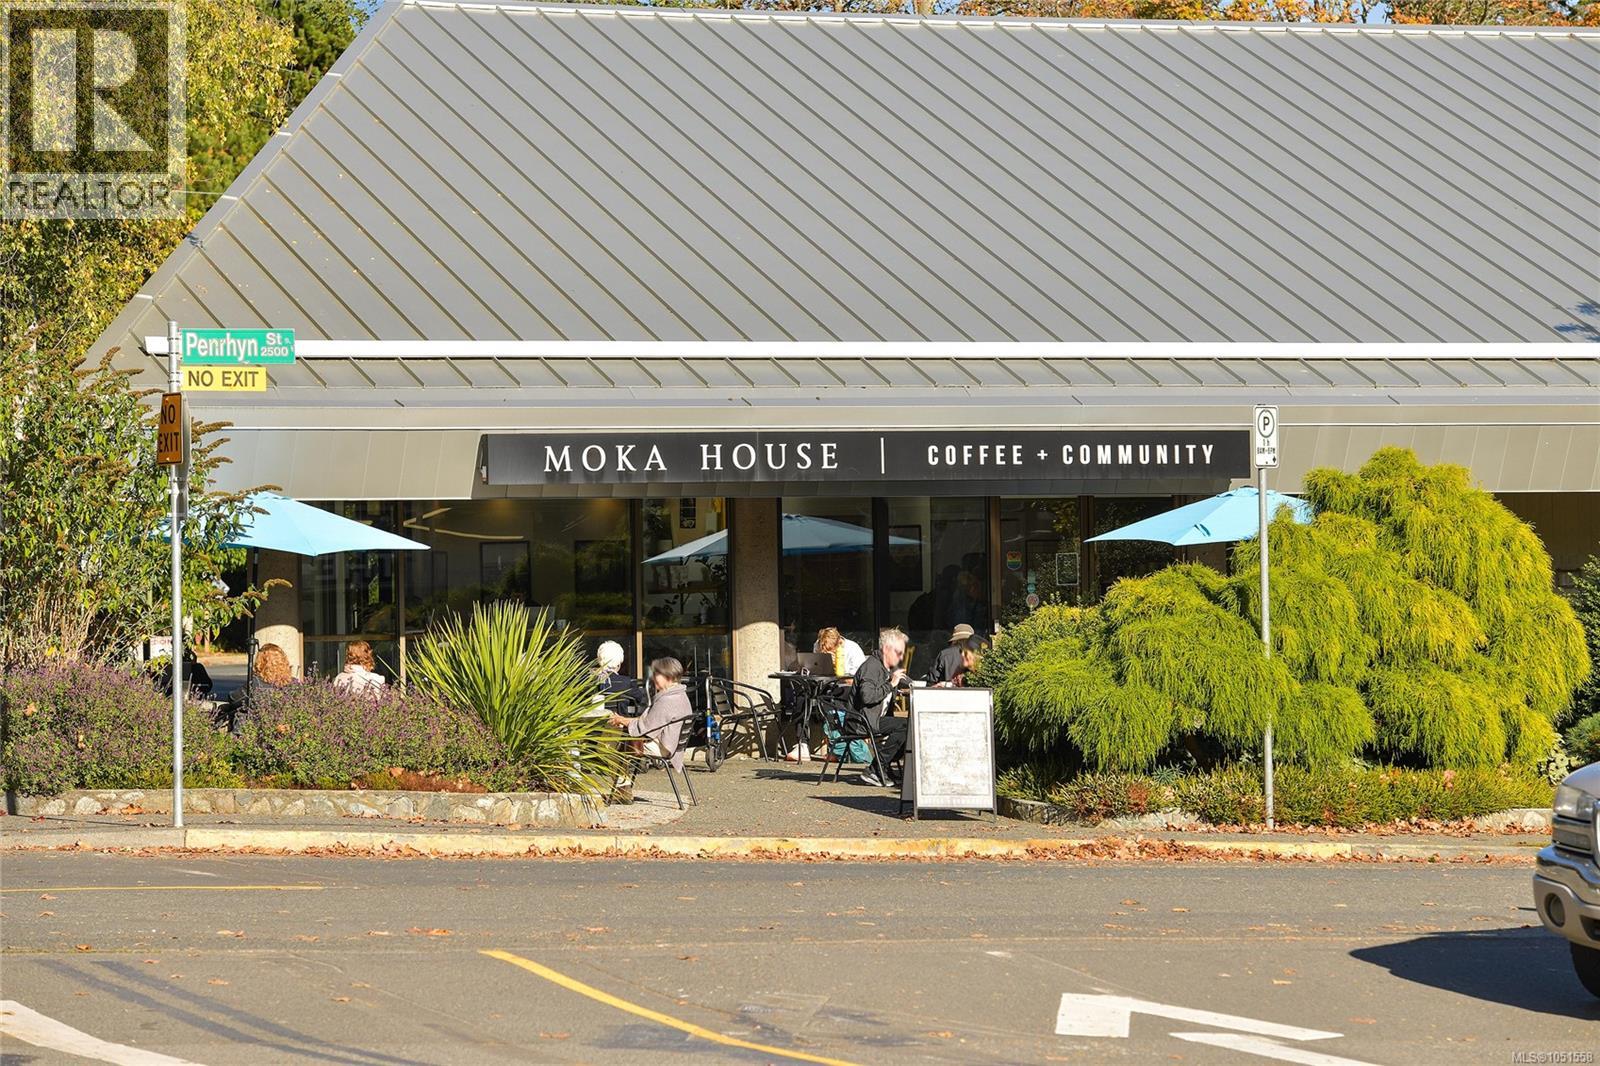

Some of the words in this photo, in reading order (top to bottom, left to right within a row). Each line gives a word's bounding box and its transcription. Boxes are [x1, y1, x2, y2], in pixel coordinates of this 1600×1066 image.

[185, 332, 259, 361] Penrhyn
[265, 332, 282, 345] St
[260, 346, 289, 357] 2500
[188, 370, 214, 387] NO
[221, 371, 259, 387] EXIT
[161, 404, 176, 425] NO
[1263, 416, 1270, 431] P
[159, 432, 180, 452] EXIT
[543, 444, 668, 473] MOKA
[700, 443, 839, 471] HOUSE
[927, 445, 1023, 466] COFFEE
[1062, 444, 1214, 465] COMMUNITY
